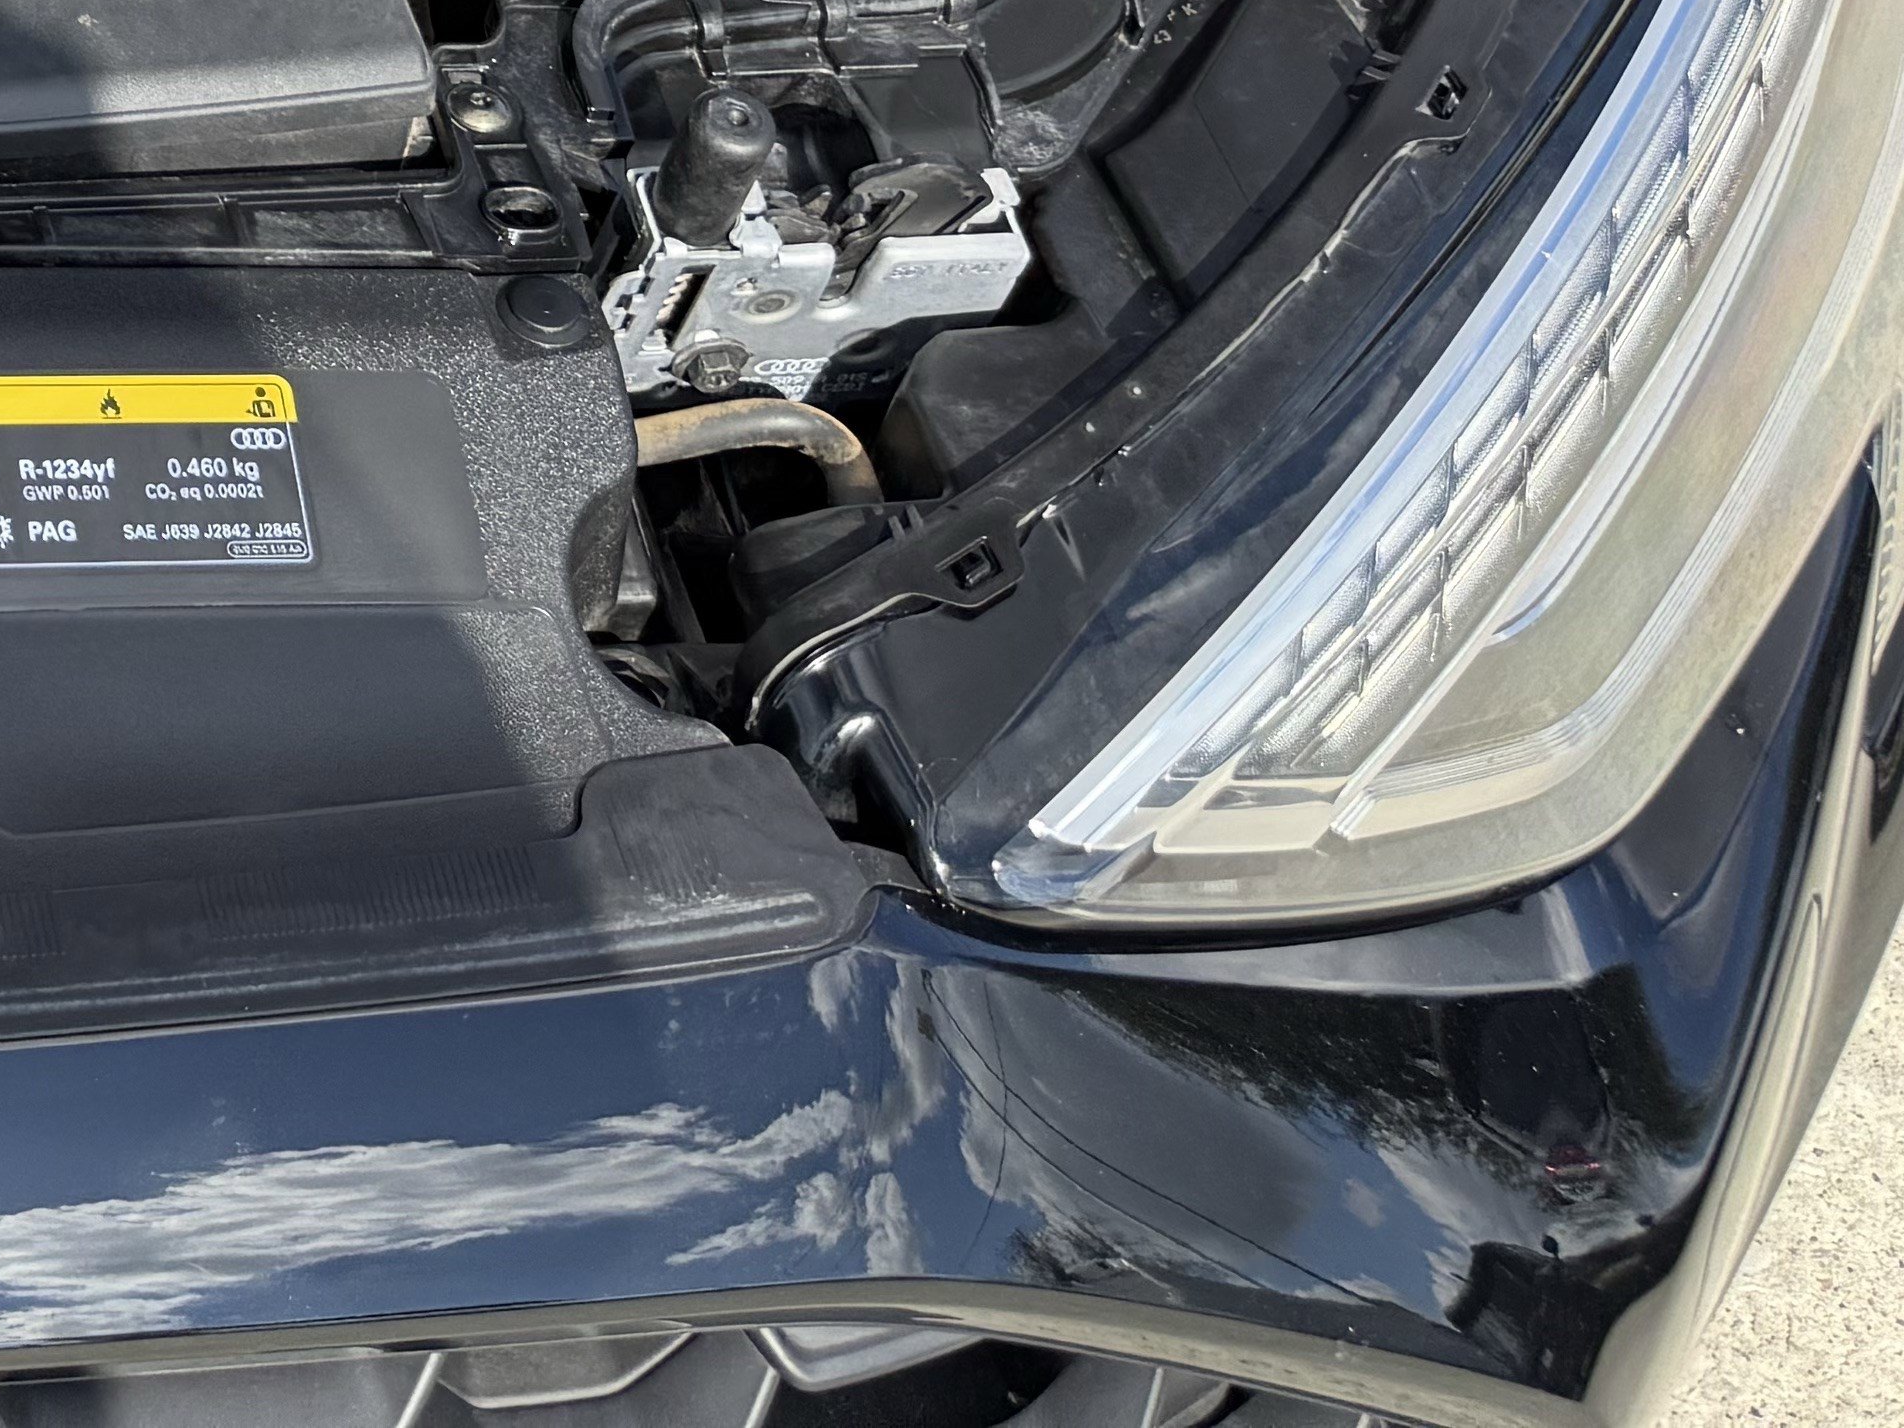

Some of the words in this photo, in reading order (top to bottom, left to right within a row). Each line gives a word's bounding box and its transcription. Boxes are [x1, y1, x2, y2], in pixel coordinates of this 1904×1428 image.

[19, 457, 115, 482] R-1234yf
[167, 457, 228, 478] 0.460
[232, 457, 260, 482] kg
[22, 486, 65, 501] GWP
[28, 521, 77, 542] PAG
[123, 524, 157, 540] SAE
[204, 523, 251, 539] J2842
[255, 522, 302, 539] J2845
